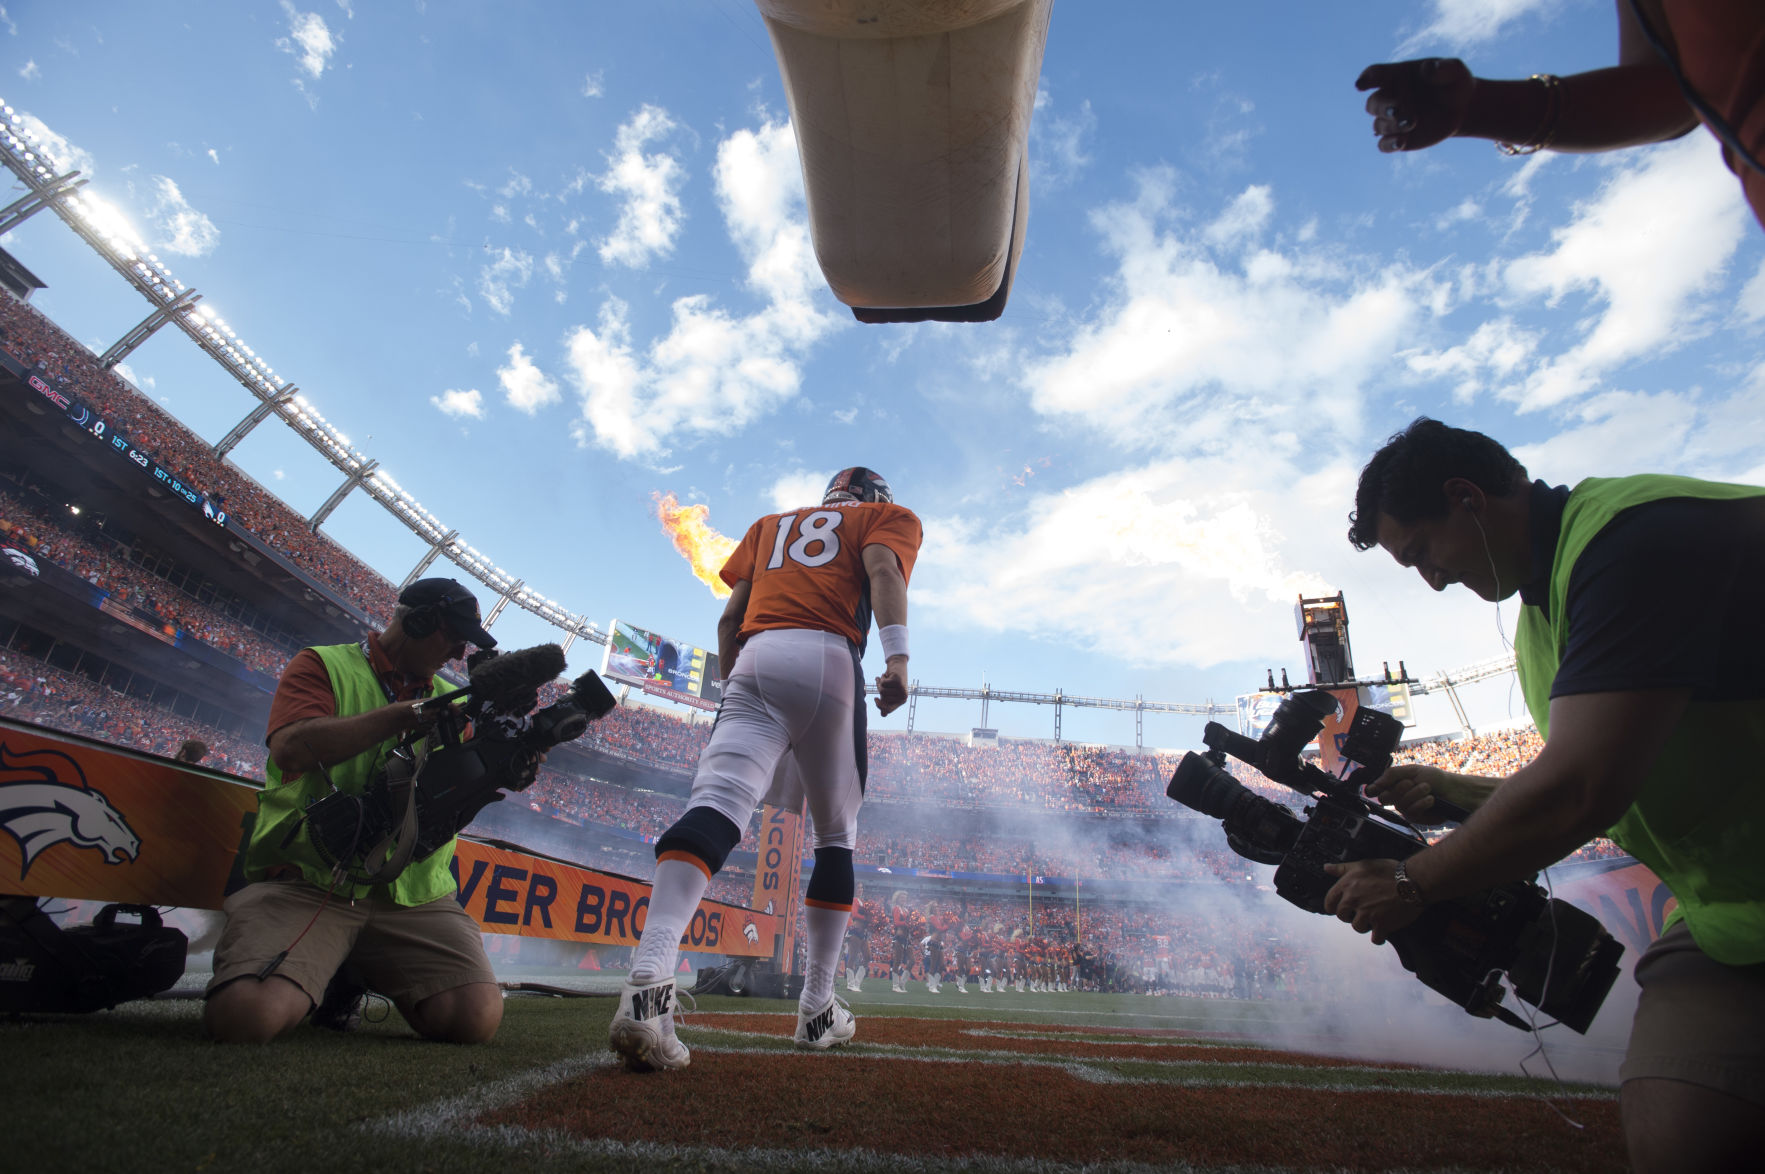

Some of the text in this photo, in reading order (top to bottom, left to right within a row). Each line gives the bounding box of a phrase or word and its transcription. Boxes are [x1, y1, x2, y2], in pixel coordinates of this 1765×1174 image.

[29, 376, 70, 410] GMC
[94, 421, 105, 434] 0
[111, 435, 129, 451] 1ST
[129, 450, 149, 467] 6:23
[153, 467, 169, 481] 1ST
[171, 480, 182, 492] 10
[185, 494, 197, 503] 25
[216, 511, 226, 523] 0
[766, 511, 843, 570] 18
[644, 684, 666, 695] SPORTS
[763, 806, 785, 891] NCOS
[449, 856, 722, 948] VER BROOS
[632, 983, 674, 1021] NIKE
[806, 1003, 835, 1042] NIKE
